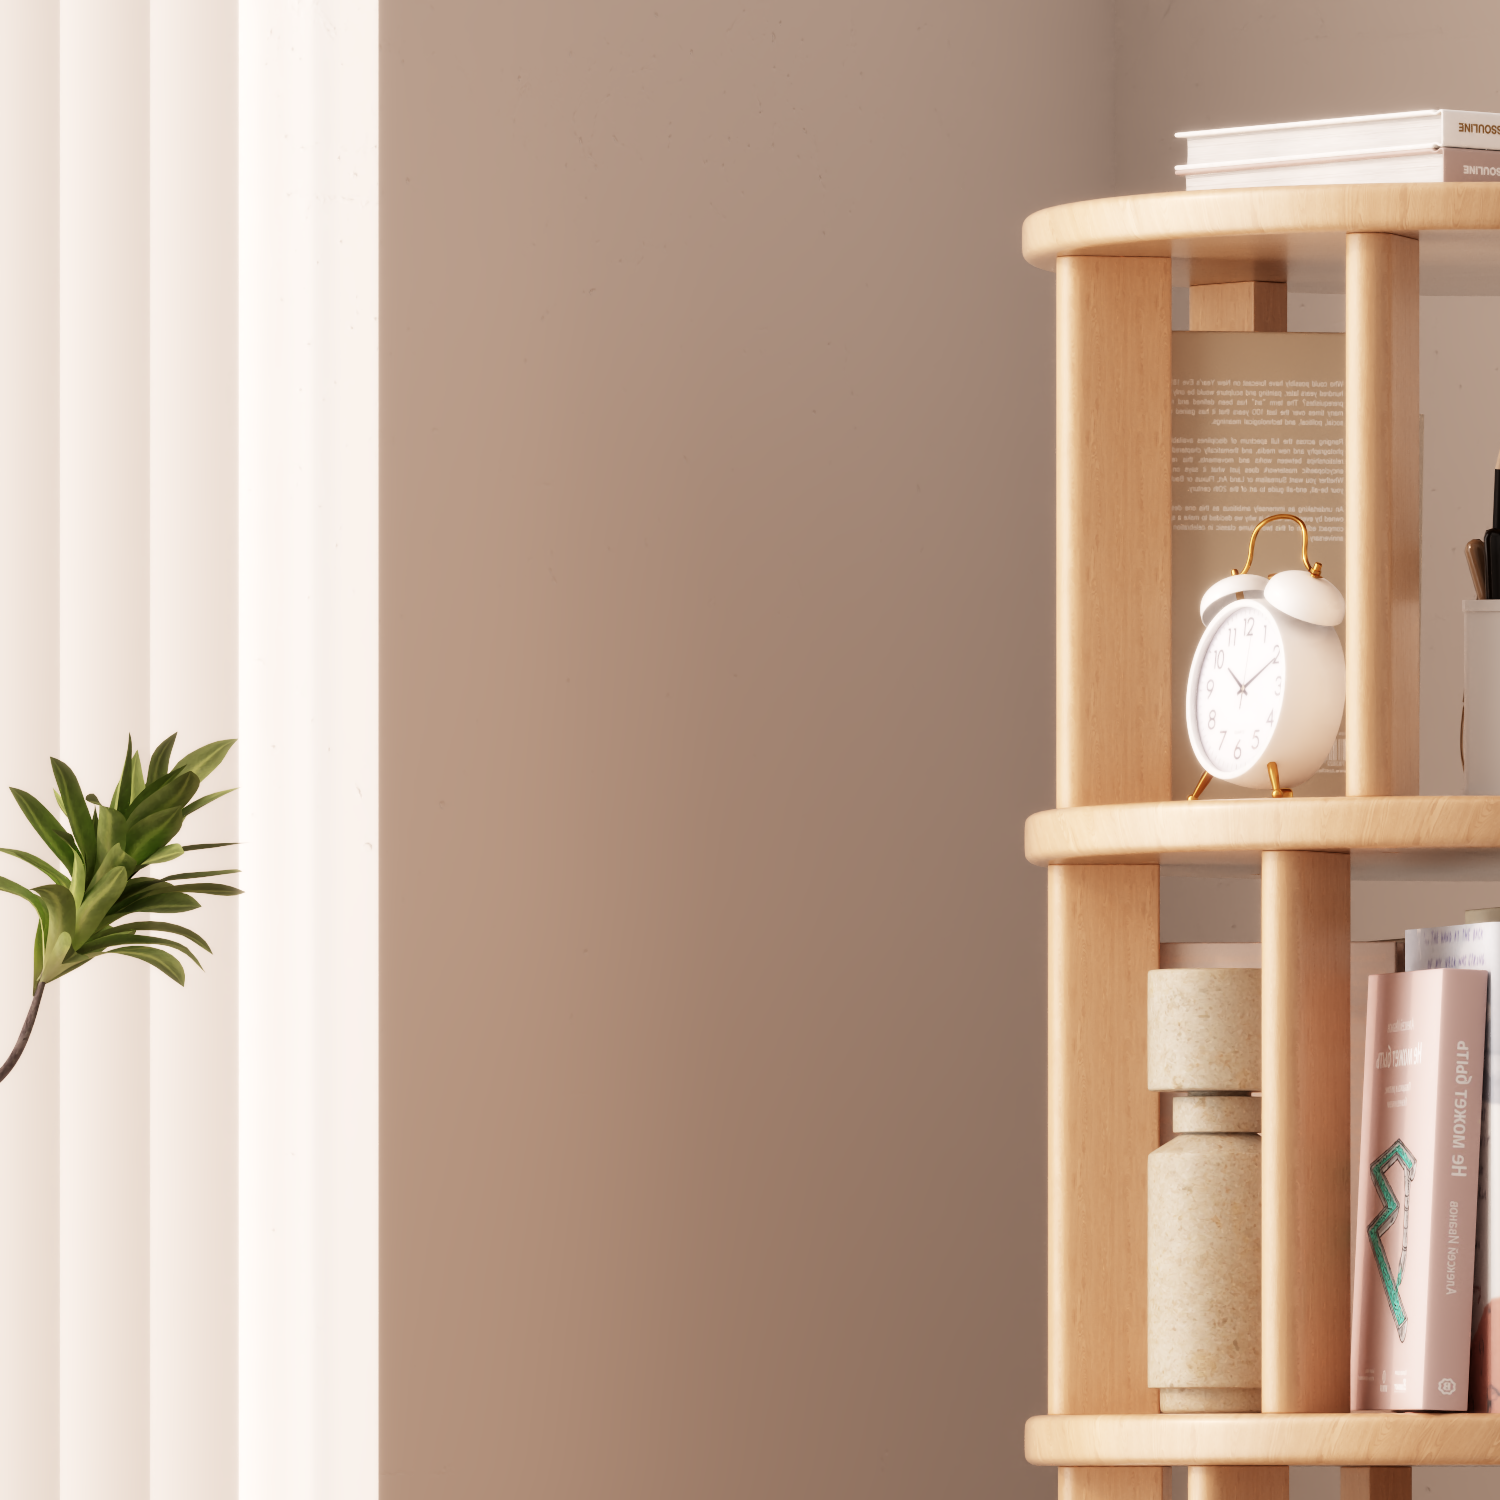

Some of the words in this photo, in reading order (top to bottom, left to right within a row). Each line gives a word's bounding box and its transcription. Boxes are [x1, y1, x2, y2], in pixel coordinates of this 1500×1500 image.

[1244, 617, 1254, 636] 12
[1264, 625, 1267, 643] 1
[1228, 628, 1236, 646] 11
[1214, 649, 1224, 669] 10
[1273, 645, 1280, 664] 2
[1206, 679, 1214, 699] 9
[1275, 676, 1282, 696] 3
[1208, 709, 1216, 730] 8
[1266, 708, 1274, 727] 4
[1219, 731, 1227, 750] 7
[1251, 729, 1259, 749] 5
[1234, 739, 1241, 760] 6
